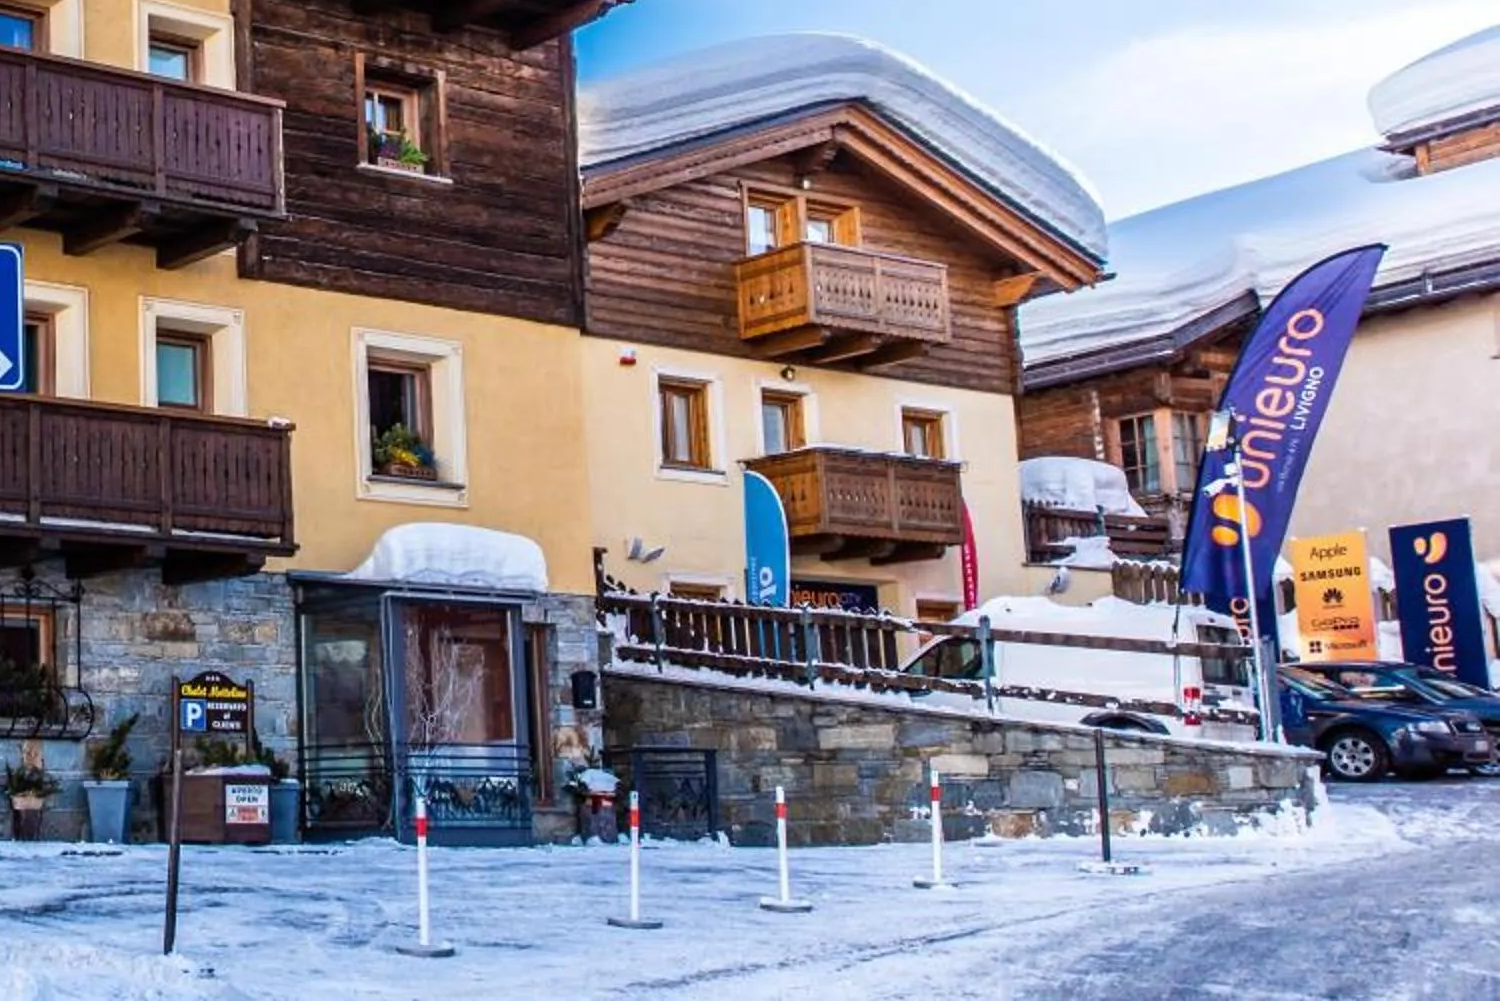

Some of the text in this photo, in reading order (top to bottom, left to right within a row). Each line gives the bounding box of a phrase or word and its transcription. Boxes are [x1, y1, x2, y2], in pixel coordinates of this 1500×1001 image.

[1241, 308, 1324, 489] unieuro
[1290, 365, 1325, 431] LIVIGNO
[1300, 566, 1361, 581] SAMSUNG
[1310, 544, 1347, 560] Apple
[1423, 573, 1458, 676] nieuro
[187, 702, 202, 728] P
